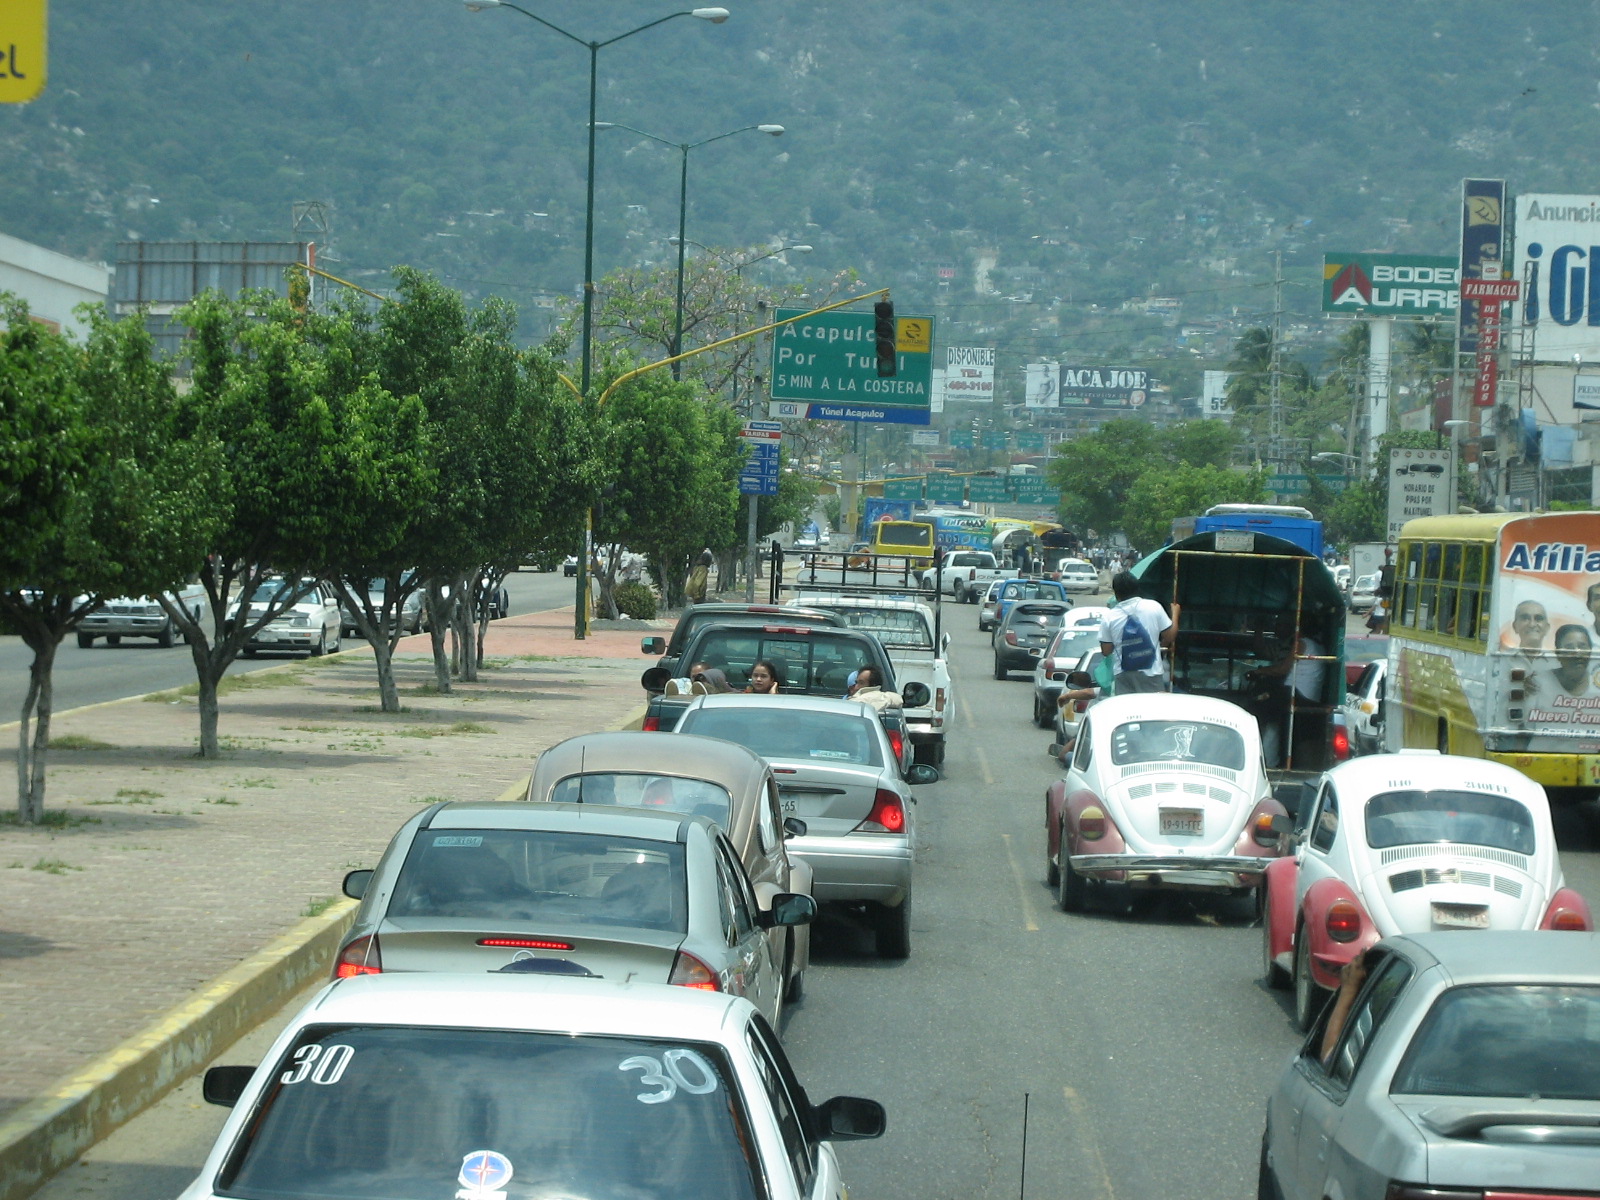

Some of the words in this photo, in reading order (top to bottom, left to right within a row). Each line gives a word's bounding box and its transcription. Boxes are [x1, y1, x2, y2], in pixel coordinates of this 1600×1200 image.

[1465, 283, 1517, 296] FARMACIA
[1484, 305, 1496, 313] DE
[782, 322, 876, 343] Acapulc
[779, 347, 816, 365] Por
[949, 348, 994, 366] DISPONIBLE
[778, 374, 786, 387] 5
[790, 375, 813, 388] MIN
[821, 378, 830, 389] A
[838, 378, 856, 391] LA
[864, 379, 924, 395] COSTERA
[1063, 369, 1104, 388] ACA
[1105, 370, 1147, 390] JOE
[821, 407, 844, 417] Túnel
[845, 408, 885, 419] Acapulco
[1403, 484, 1427, 492] HORARIO
[1428, 484, 1435, 493] DE
[1553, 695, 1600, 708] Acapul
[1529, 709, 1569, 722] Nueva
[280, 1044, 355, 1085] 30
[619, 1049, 718, 1104] 30
